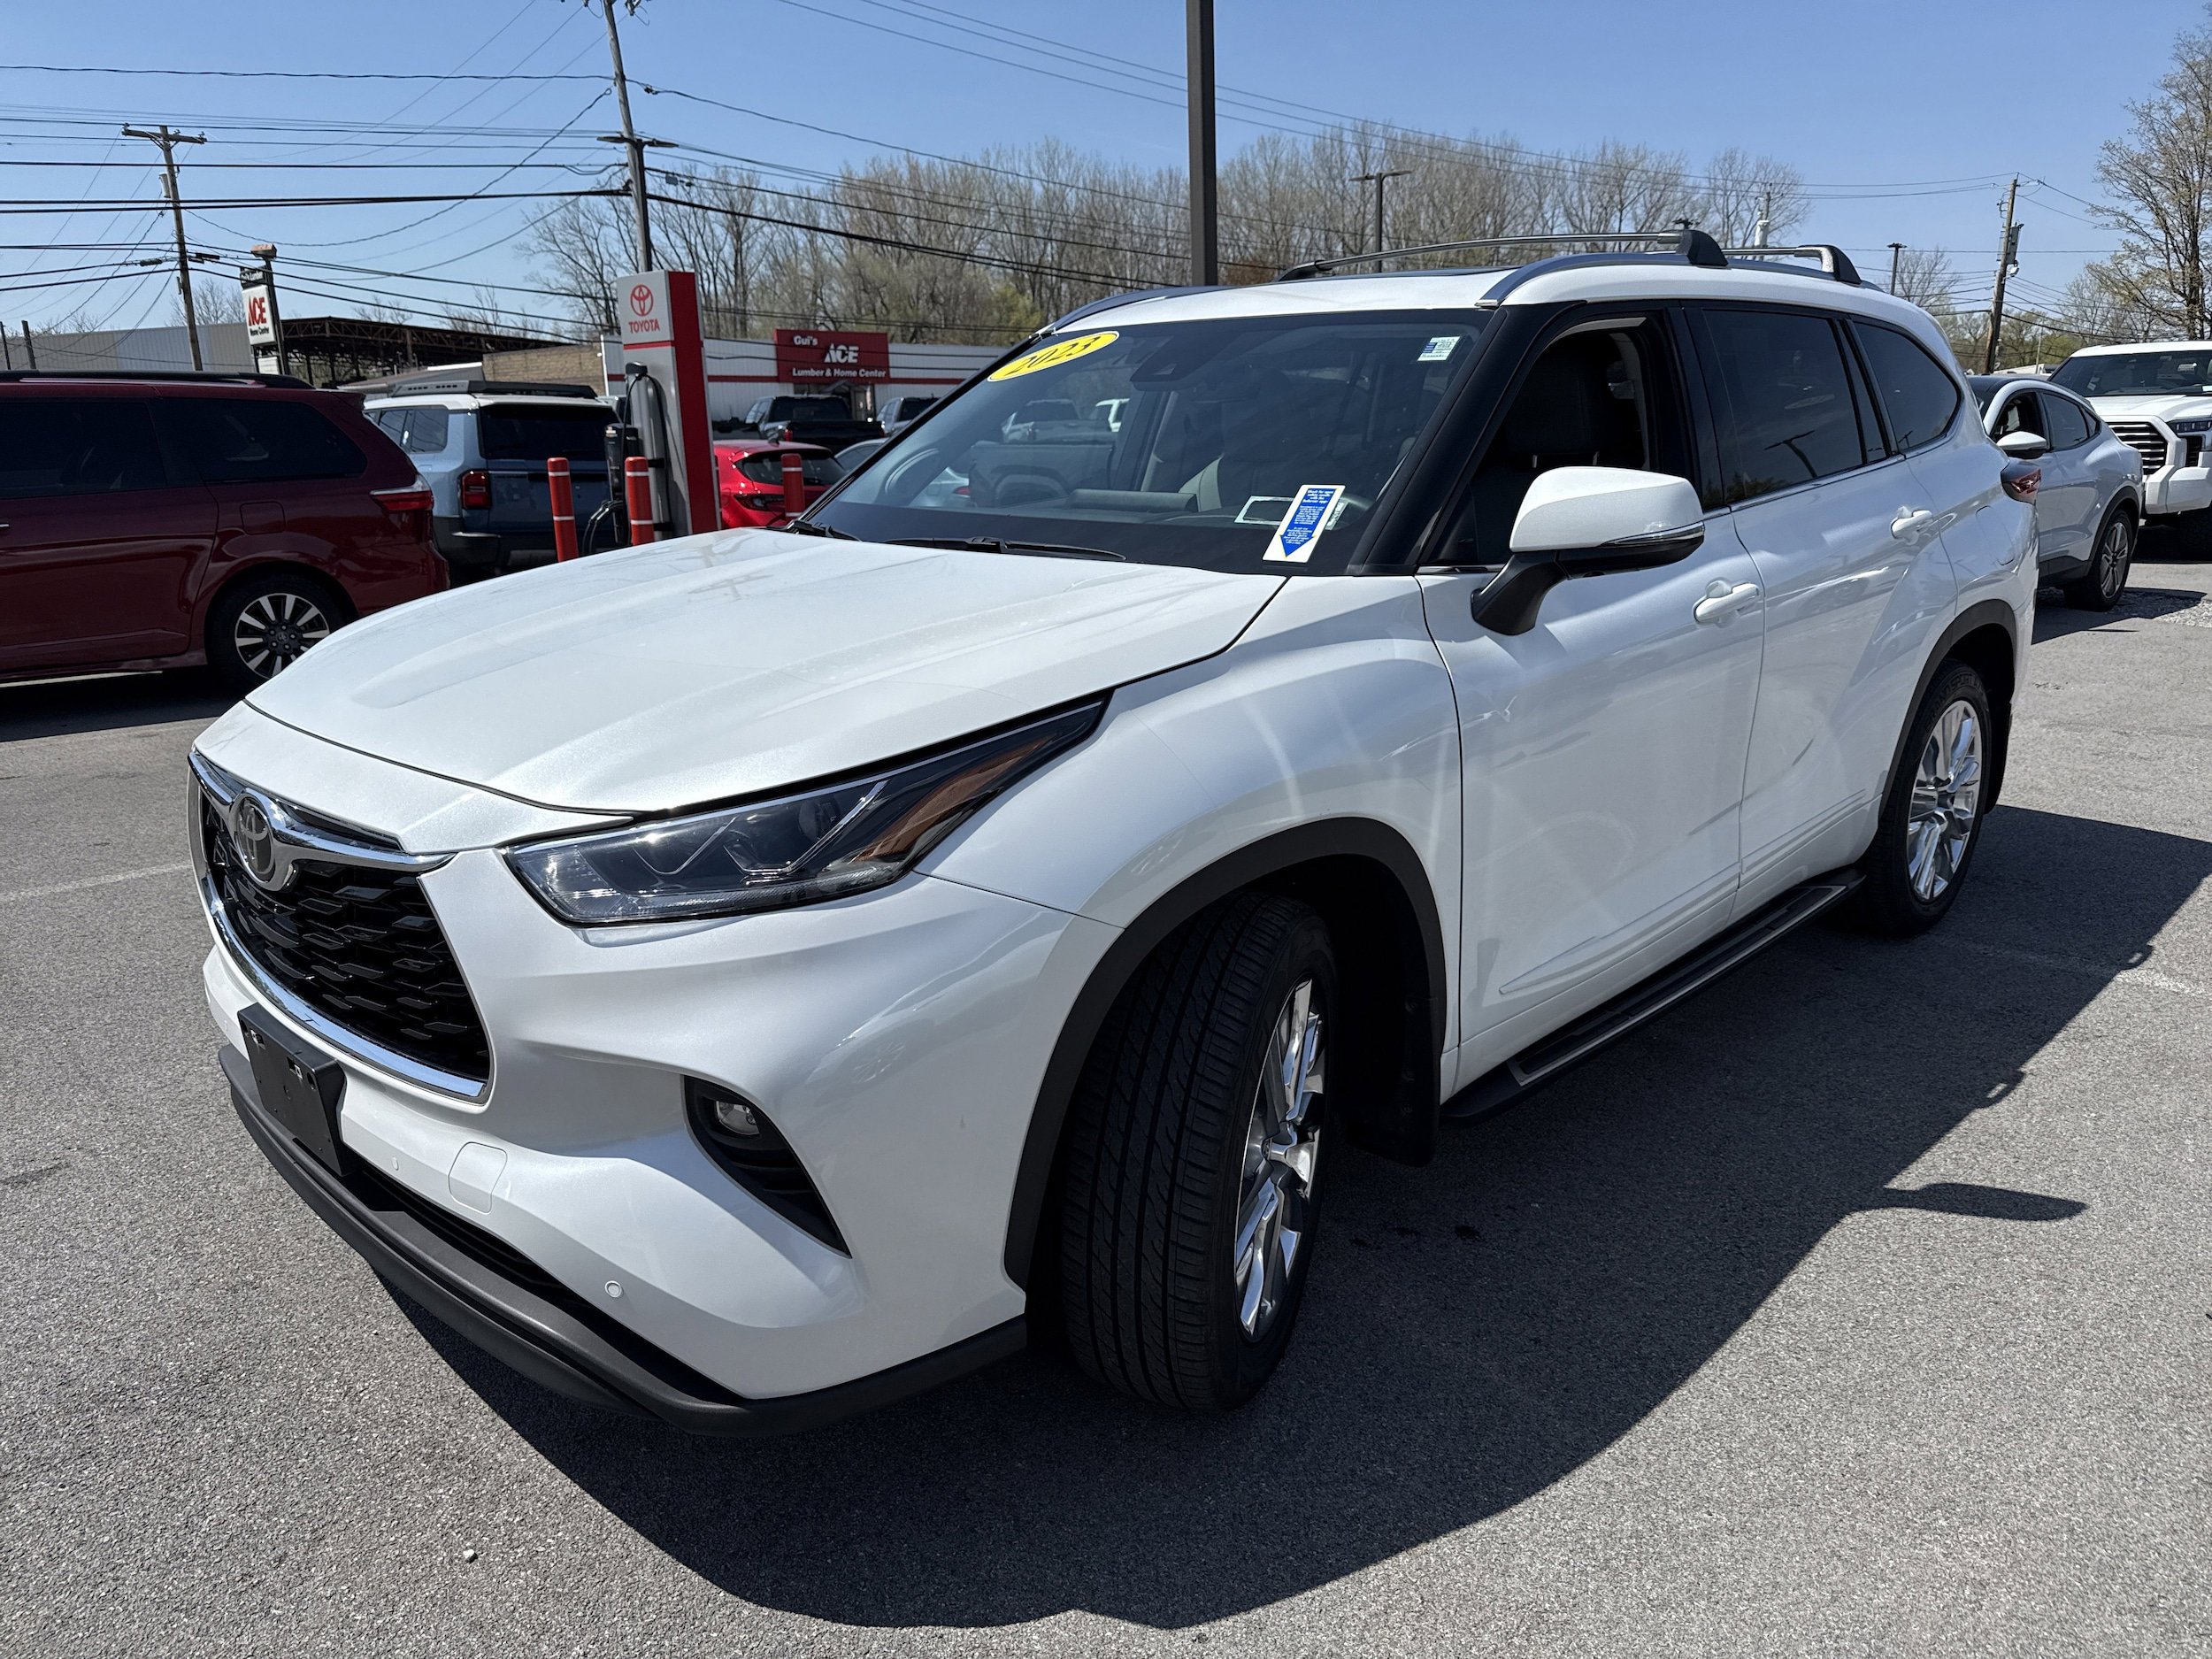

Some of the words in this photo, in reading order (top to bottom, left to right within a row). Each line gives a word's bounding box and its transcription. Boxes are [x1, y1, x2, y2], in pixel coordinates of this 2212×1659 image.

[249, 296, 267, 326] ACE
[628, 319, 660, 334] TOYOTA
[793, 335, 818, 346] Gui's
[824, 343, 859, 363] ACE
[1002, 336, 1101, 377] 2023
[792, 367, 825, 377] Lumber
[825, 368, 832, 377] &
[833, 368, 857, 377] Home
[858, 368, 887, 378] Center
